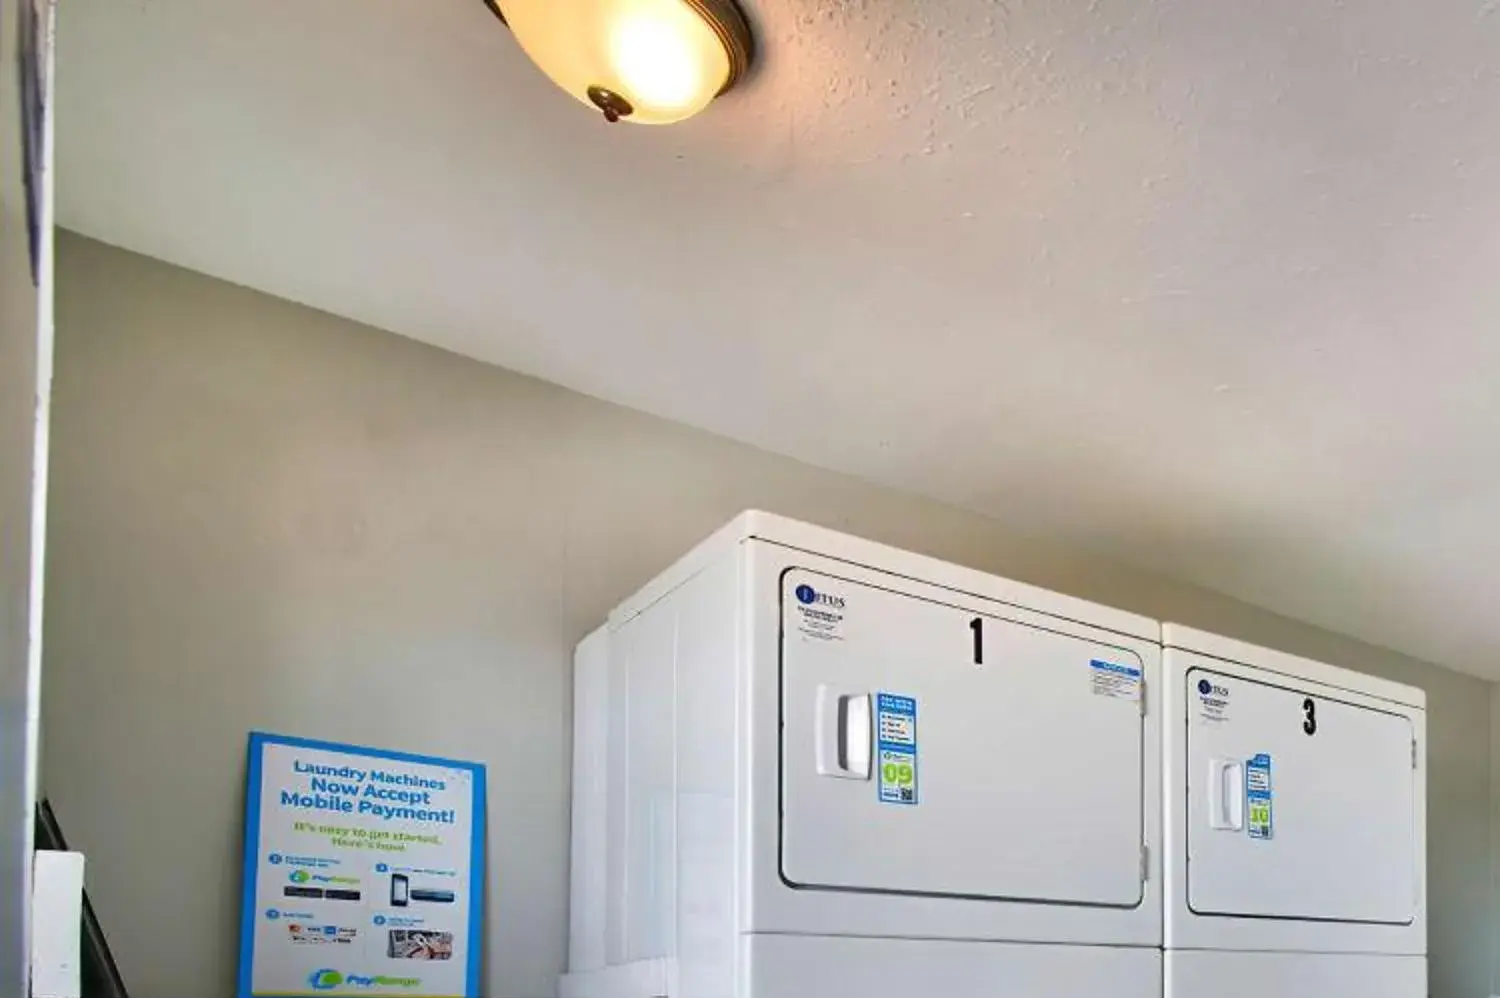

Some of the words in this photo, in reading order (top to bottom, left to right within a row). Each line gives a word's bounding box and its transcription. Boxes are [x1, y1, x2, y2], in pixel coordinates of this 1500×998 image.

[969, 618, 983, 664] 1
[1302, 698, 1317, 736] 3
[293, 759, 366, 782] Laundry
[370, 770, 446, 791] Machines
[883, 763, 912, 784] 09
[280, 790, 353, 812] Mobile
[358, 801, 455, 824] Payment!
[311, 778, 359, 797] Now
[364, 784, 431, 805] Accept
